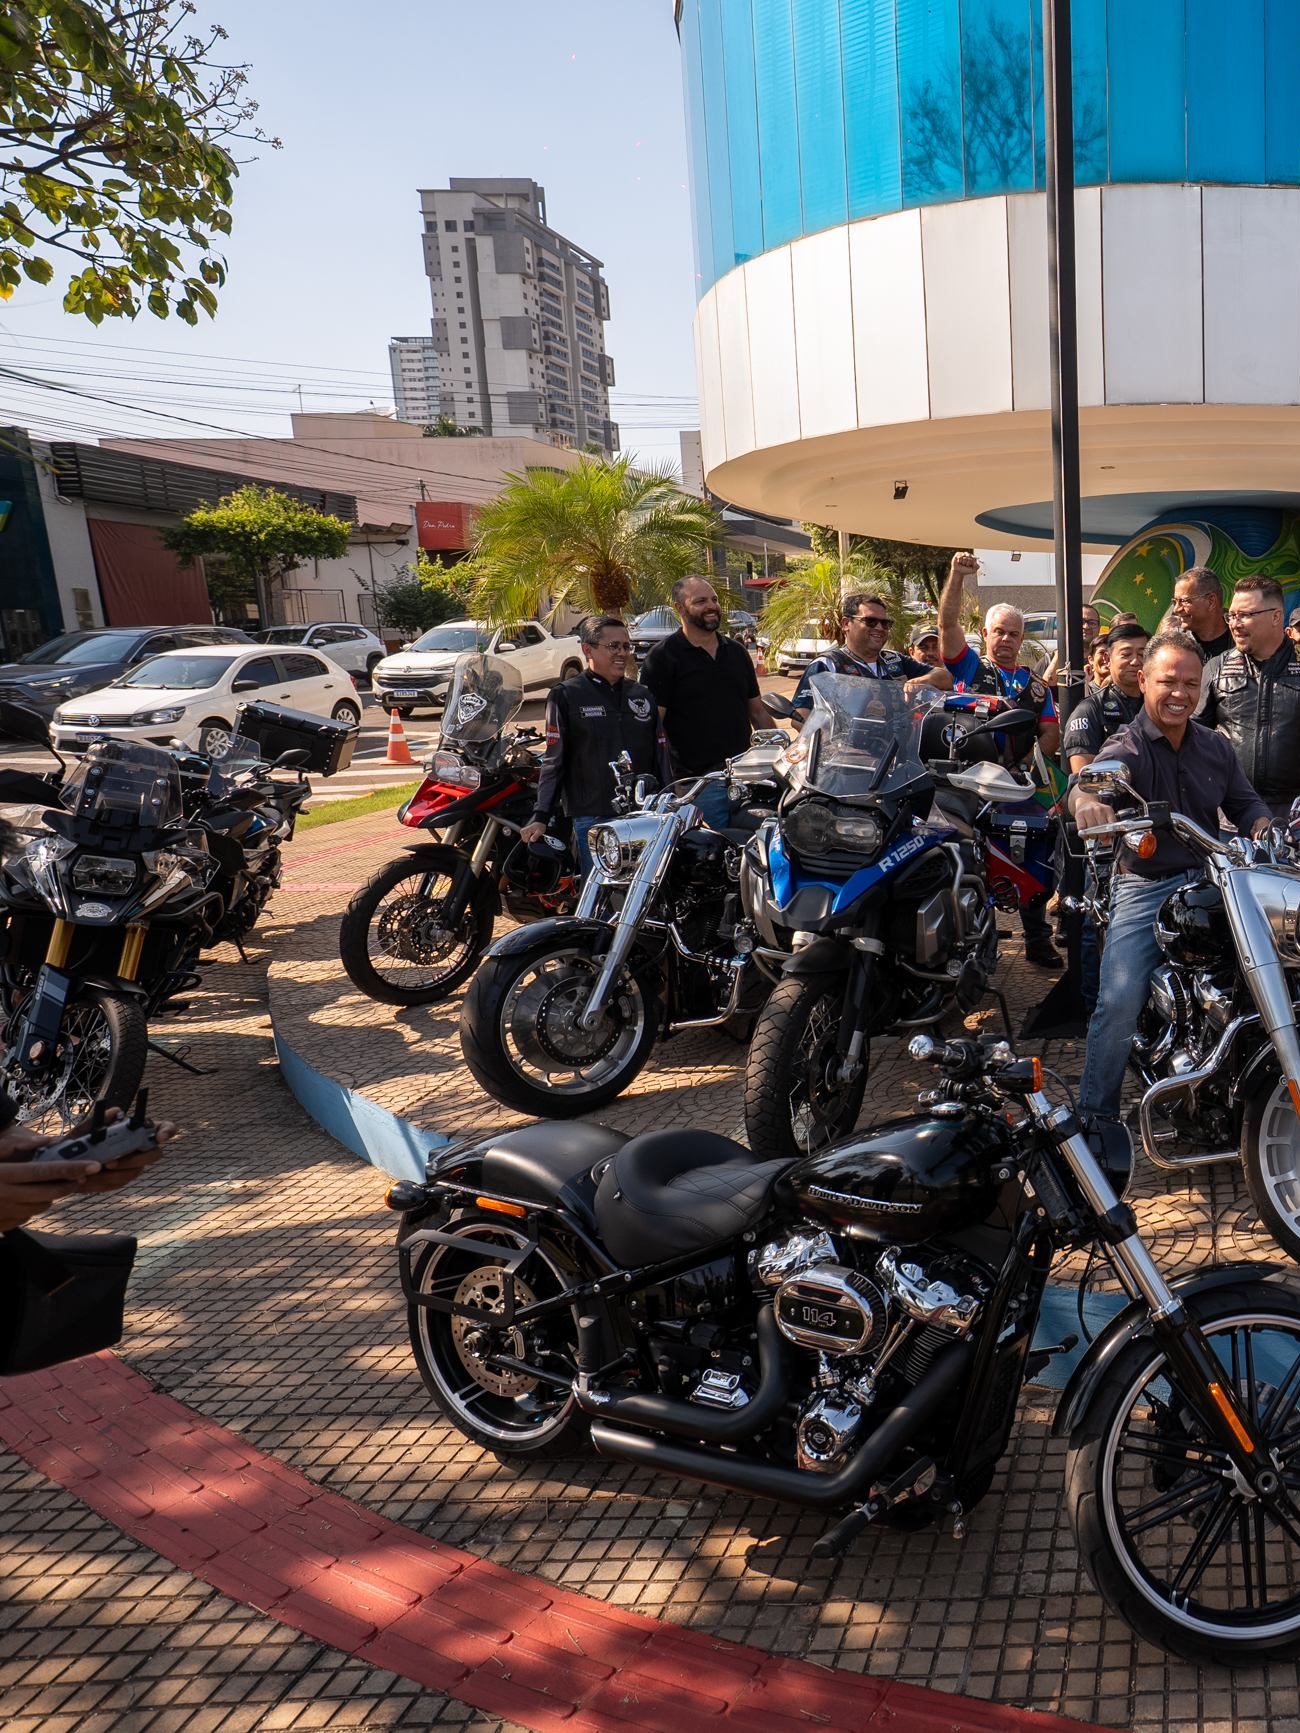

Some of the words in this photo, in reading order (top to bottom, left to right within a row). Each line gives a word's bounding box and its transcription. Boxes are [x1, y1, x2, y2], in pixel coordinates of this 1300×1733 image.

[878, 857, 895, 873] R
[892, 835, 925, 863] 1250
[808, 1184, 924, 1213] HARLEY-DAVIDSON
[803, 1306, 837, 1327] 114
